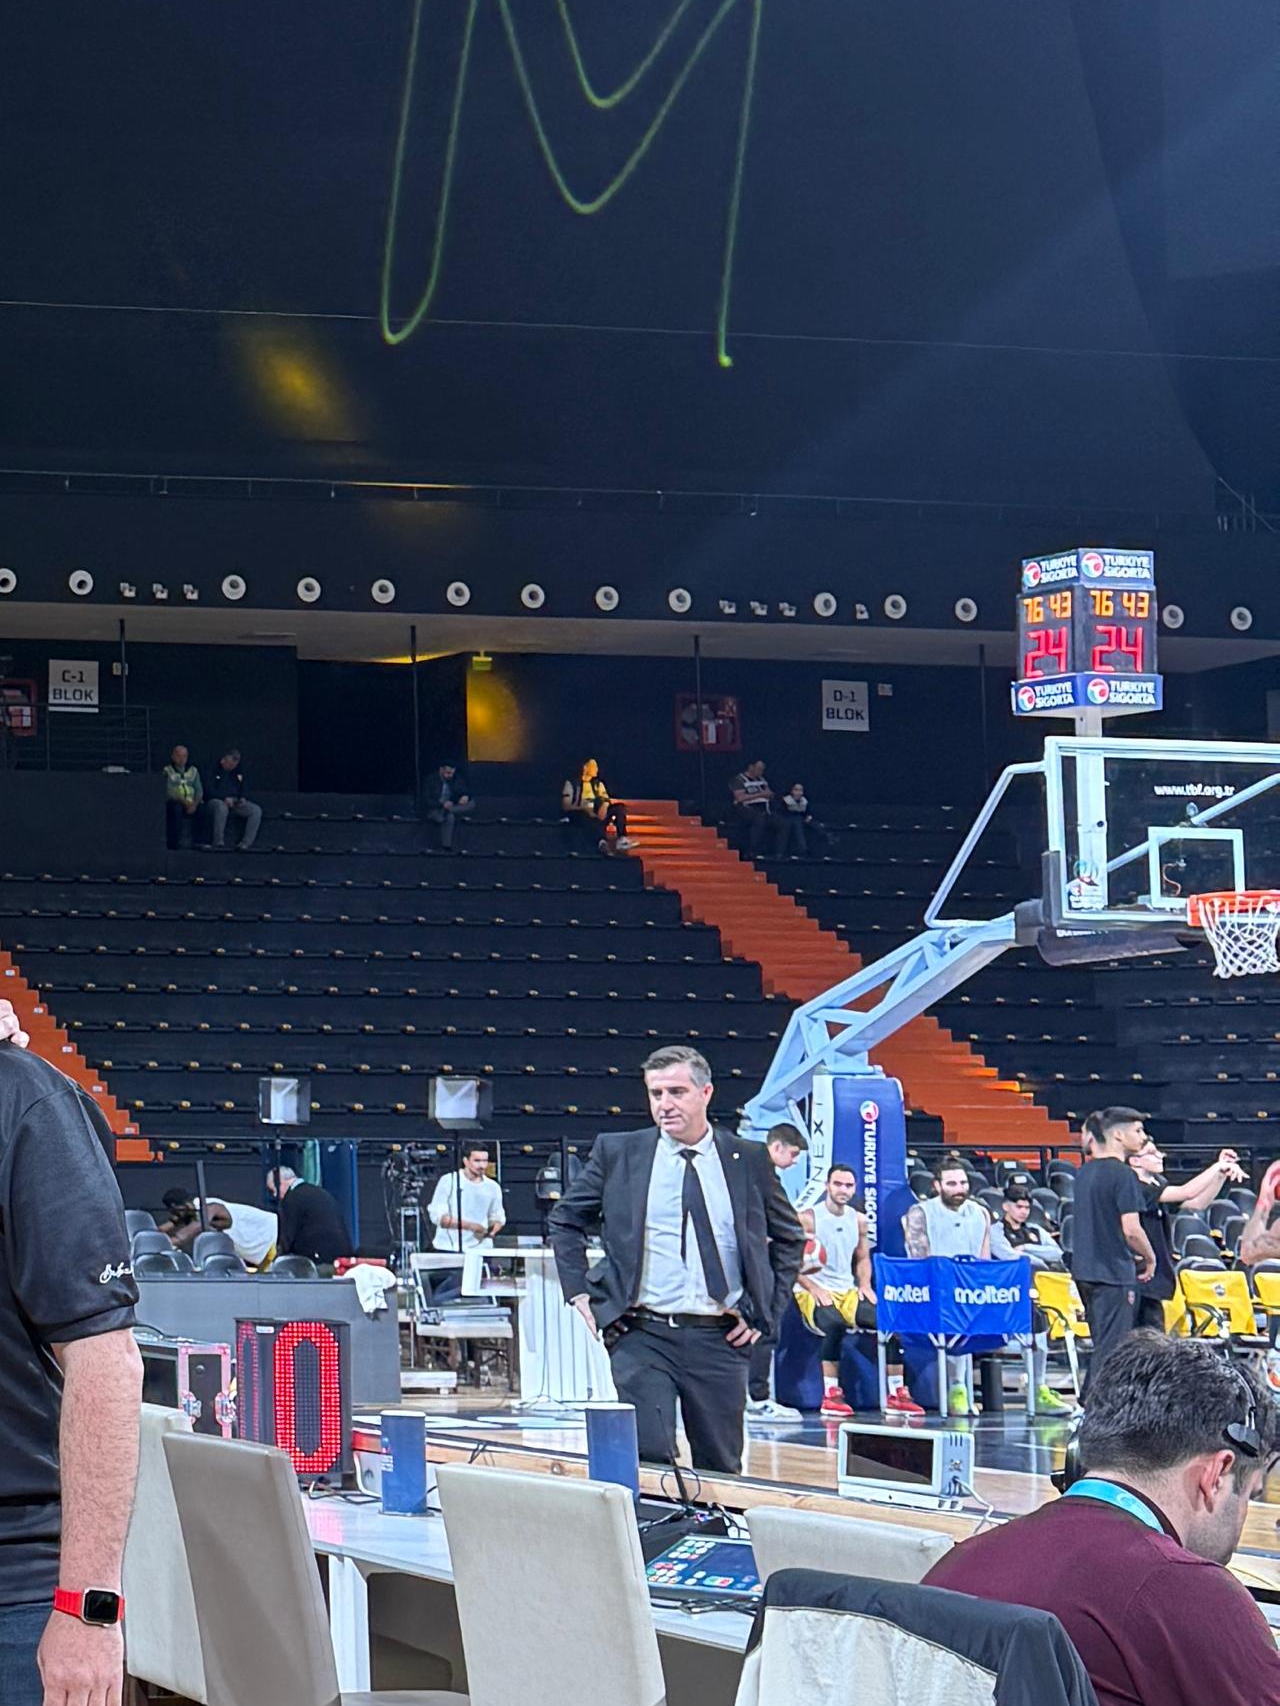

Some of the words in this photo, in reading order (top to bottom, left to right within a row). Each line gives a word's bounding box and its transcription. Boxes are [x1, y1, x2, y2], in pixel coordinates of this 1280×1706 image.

[1024, 597, 1044, 623] 76
[1049, 591, 1072, 618] 43
[1090, 590, 1114, 616] 76
[1122, 592, 1149, 618] 43
[1025, 626, 1067, 678] 24
[1093, 625, 1144, 673] 24
[62, 669, 85, 683] C-1
[52, 688, 94, 701] BLOK
[833, 690, 857, 702] D-1
[825, 707, 865, 721] BLOK
[954, 1285, 1020, 1304] molten
[274, 1321, 341, 1474] 0
